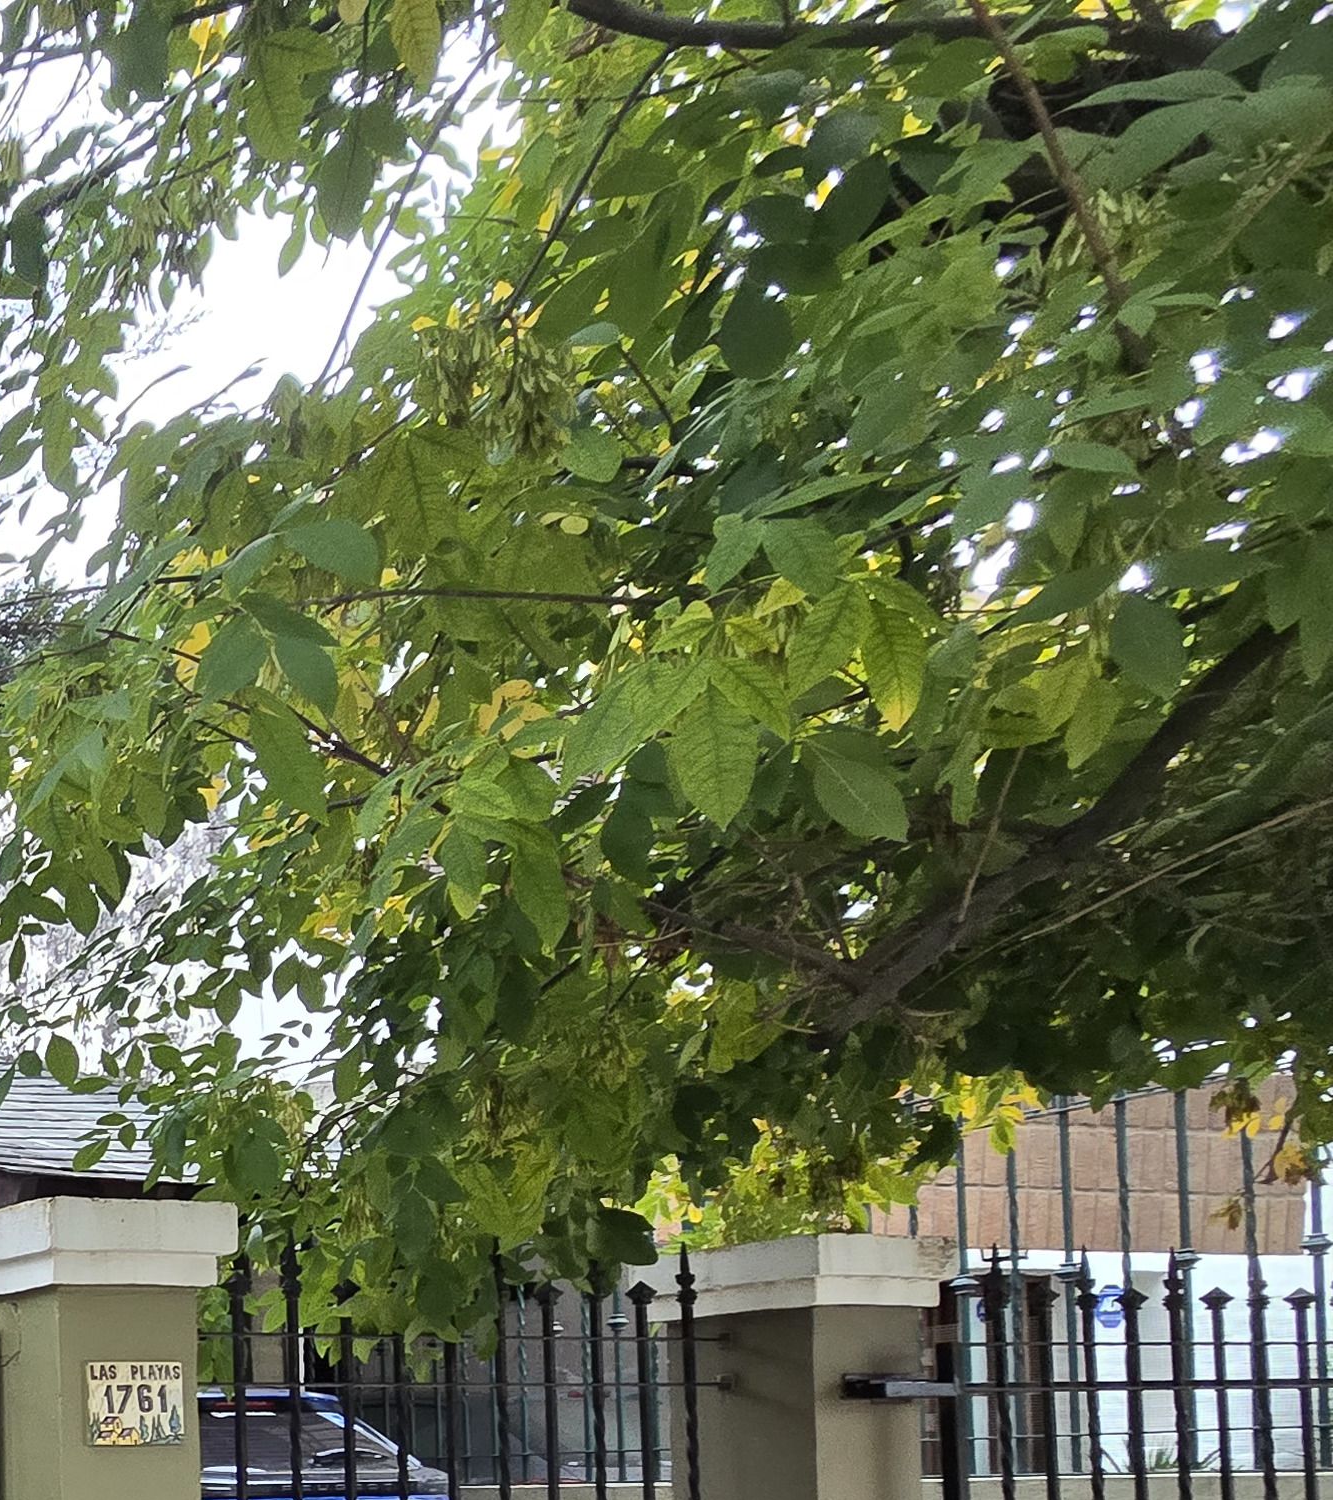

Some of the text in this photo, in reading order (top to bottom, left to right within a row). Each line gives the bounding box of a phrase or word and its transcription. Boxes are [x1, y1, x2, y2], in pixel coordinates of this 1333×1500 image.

[89, 1364, 181, 1380] LAS PLAYAS
[103, 1384, 168, 1413] 1761
